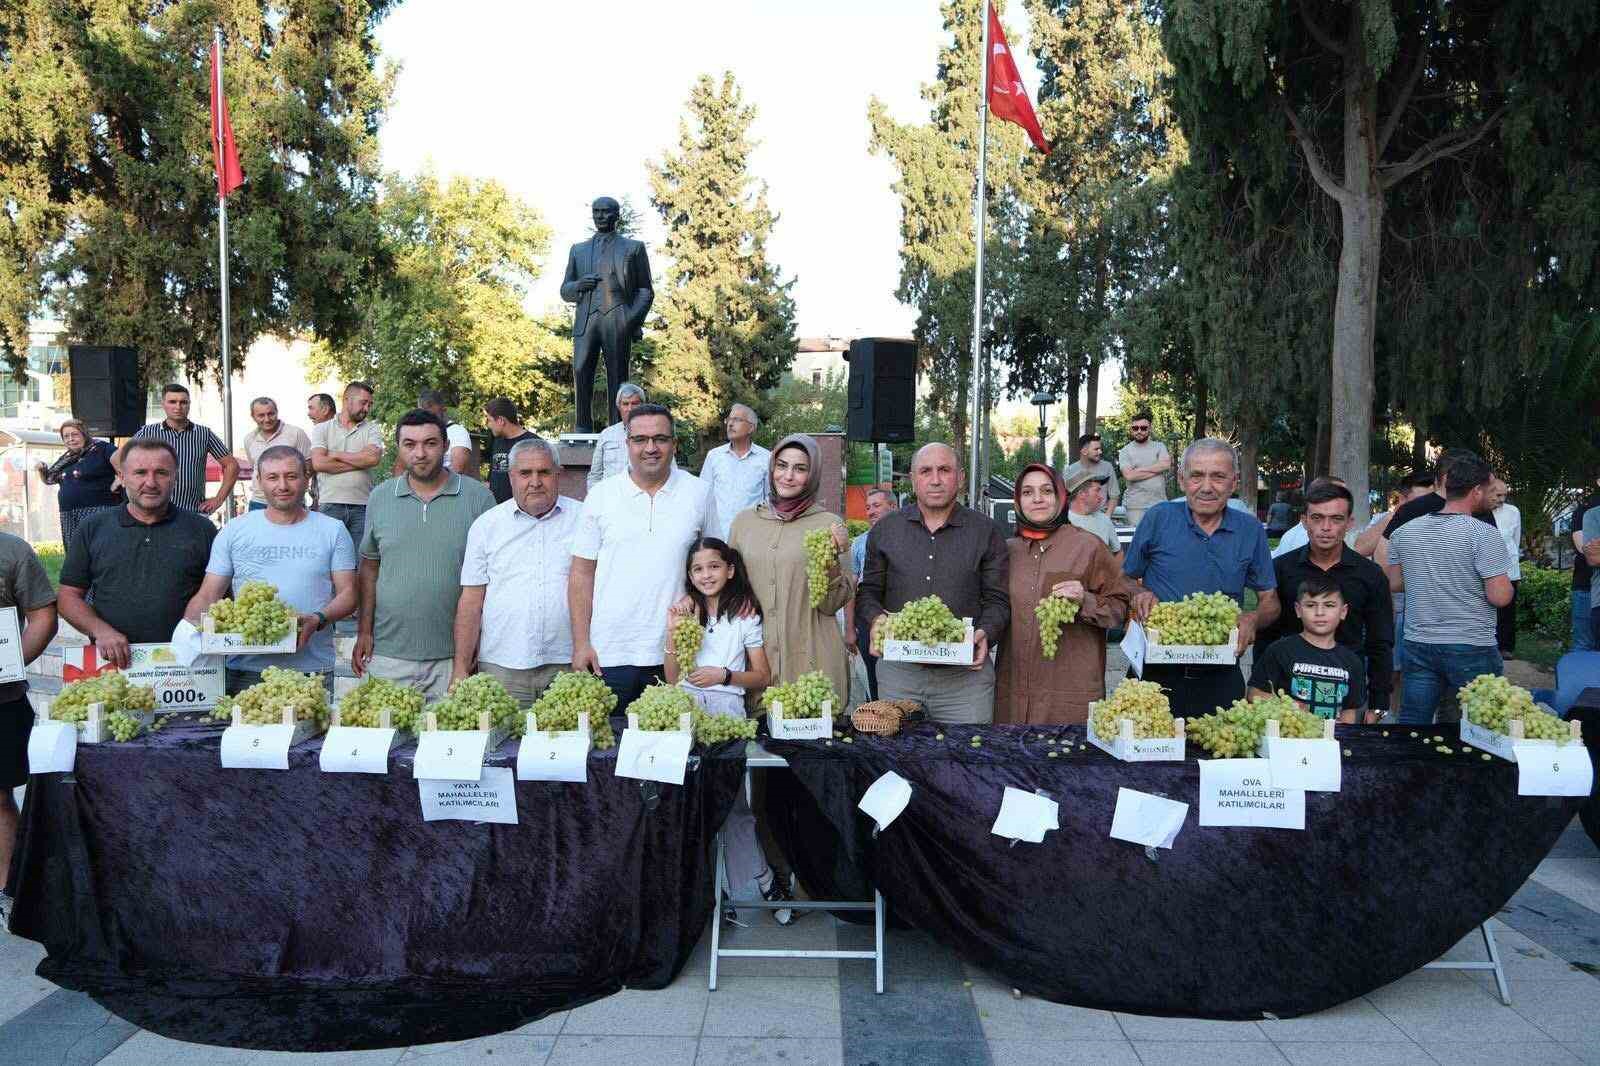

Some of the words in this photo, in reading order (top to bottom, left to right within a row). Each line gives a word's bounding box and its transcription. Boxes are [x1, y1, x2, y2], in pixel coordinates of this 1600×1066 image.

[252, 738, 260, 748] 5
[352, 748, 359, 758] 4
[447, 747, 454, 757] 3
[549, 751, 556, 761] 2
[1302, 756, 1309, 766] 4
[1552, 762, 1560, 773] 6
[1242, 778, 1262, 787] OVA
